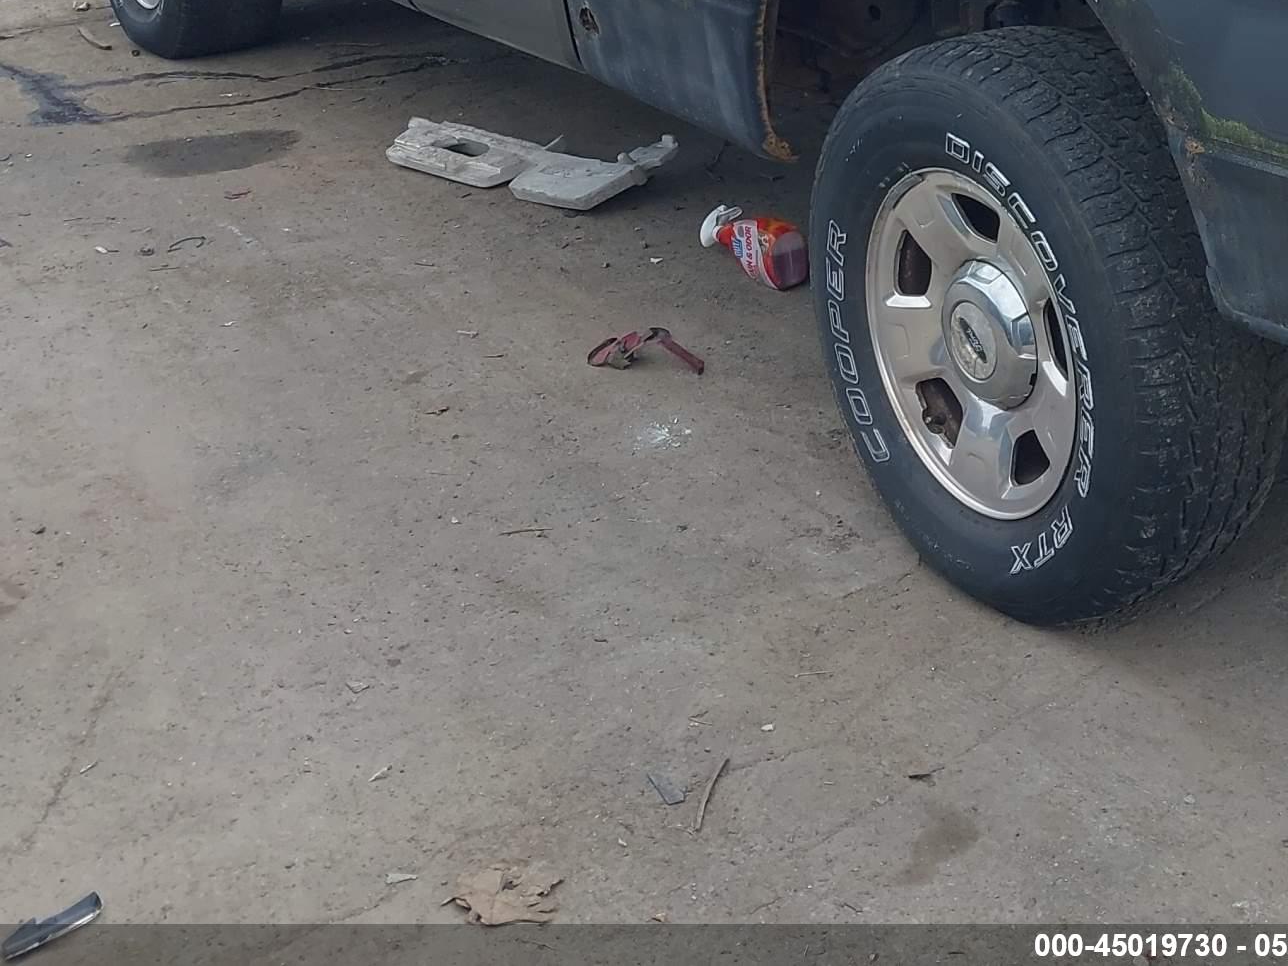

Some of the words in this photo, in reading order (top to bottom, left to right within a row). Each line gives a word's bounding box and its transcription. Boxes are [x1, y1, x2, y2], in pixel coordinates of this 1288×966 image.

[744, 226, 753, 252] ODOR
[945, 132, 1095, 498] DISCOVERER
[826, 219, 890, 463] COOPER
[1009, 506, 1074, 575] RTX
